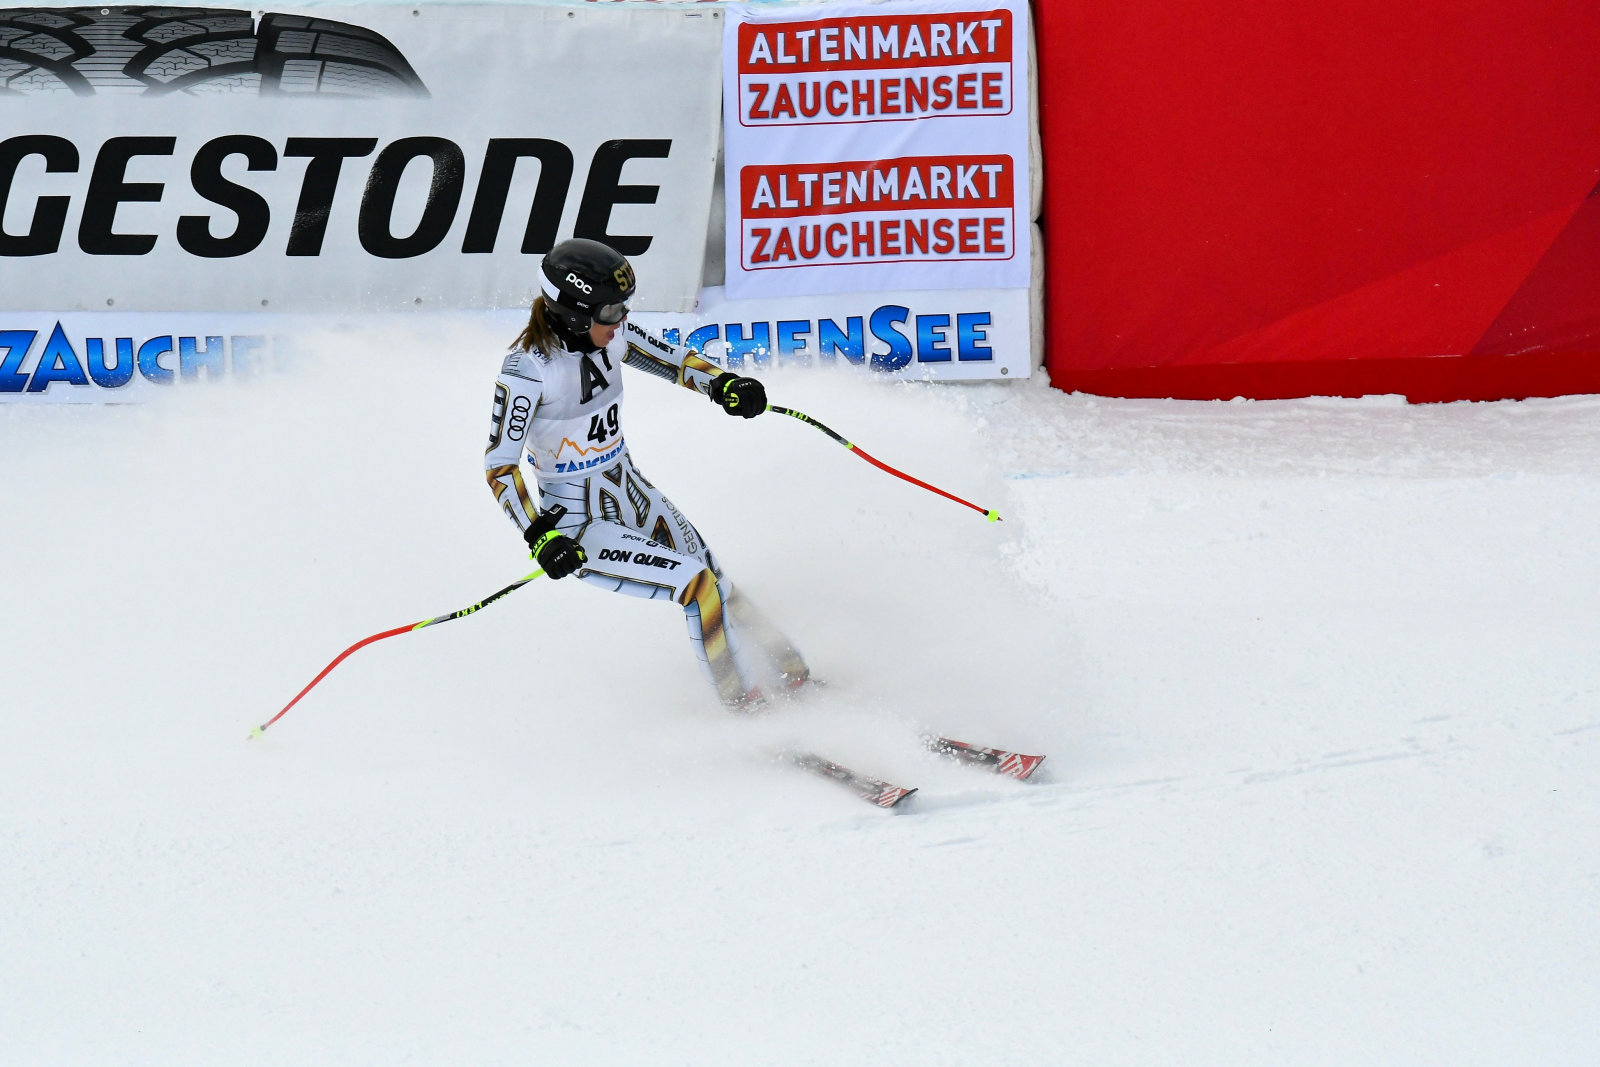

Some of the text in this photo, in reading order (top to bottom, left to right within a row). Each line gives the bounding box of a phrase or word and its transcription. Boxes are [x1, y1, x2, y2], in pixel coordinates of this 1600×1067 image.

[748, 19, 1002, 65] ALTENMARKT
[748, 72, 1003, 119] ZAUCHENSEE
[751, 164, 1003, 209] ALTENMARKT
[750, 217, 1005, 264] ZAUCHENSEE
[627, 322, 676, 355] DON QUIET
[587, 403, 619, 443] 49
[621, 533, 647, 543] SPORT
[661, 496, 698, 555] GENETICS
[598, 548, 682, 570] DON QUIET
